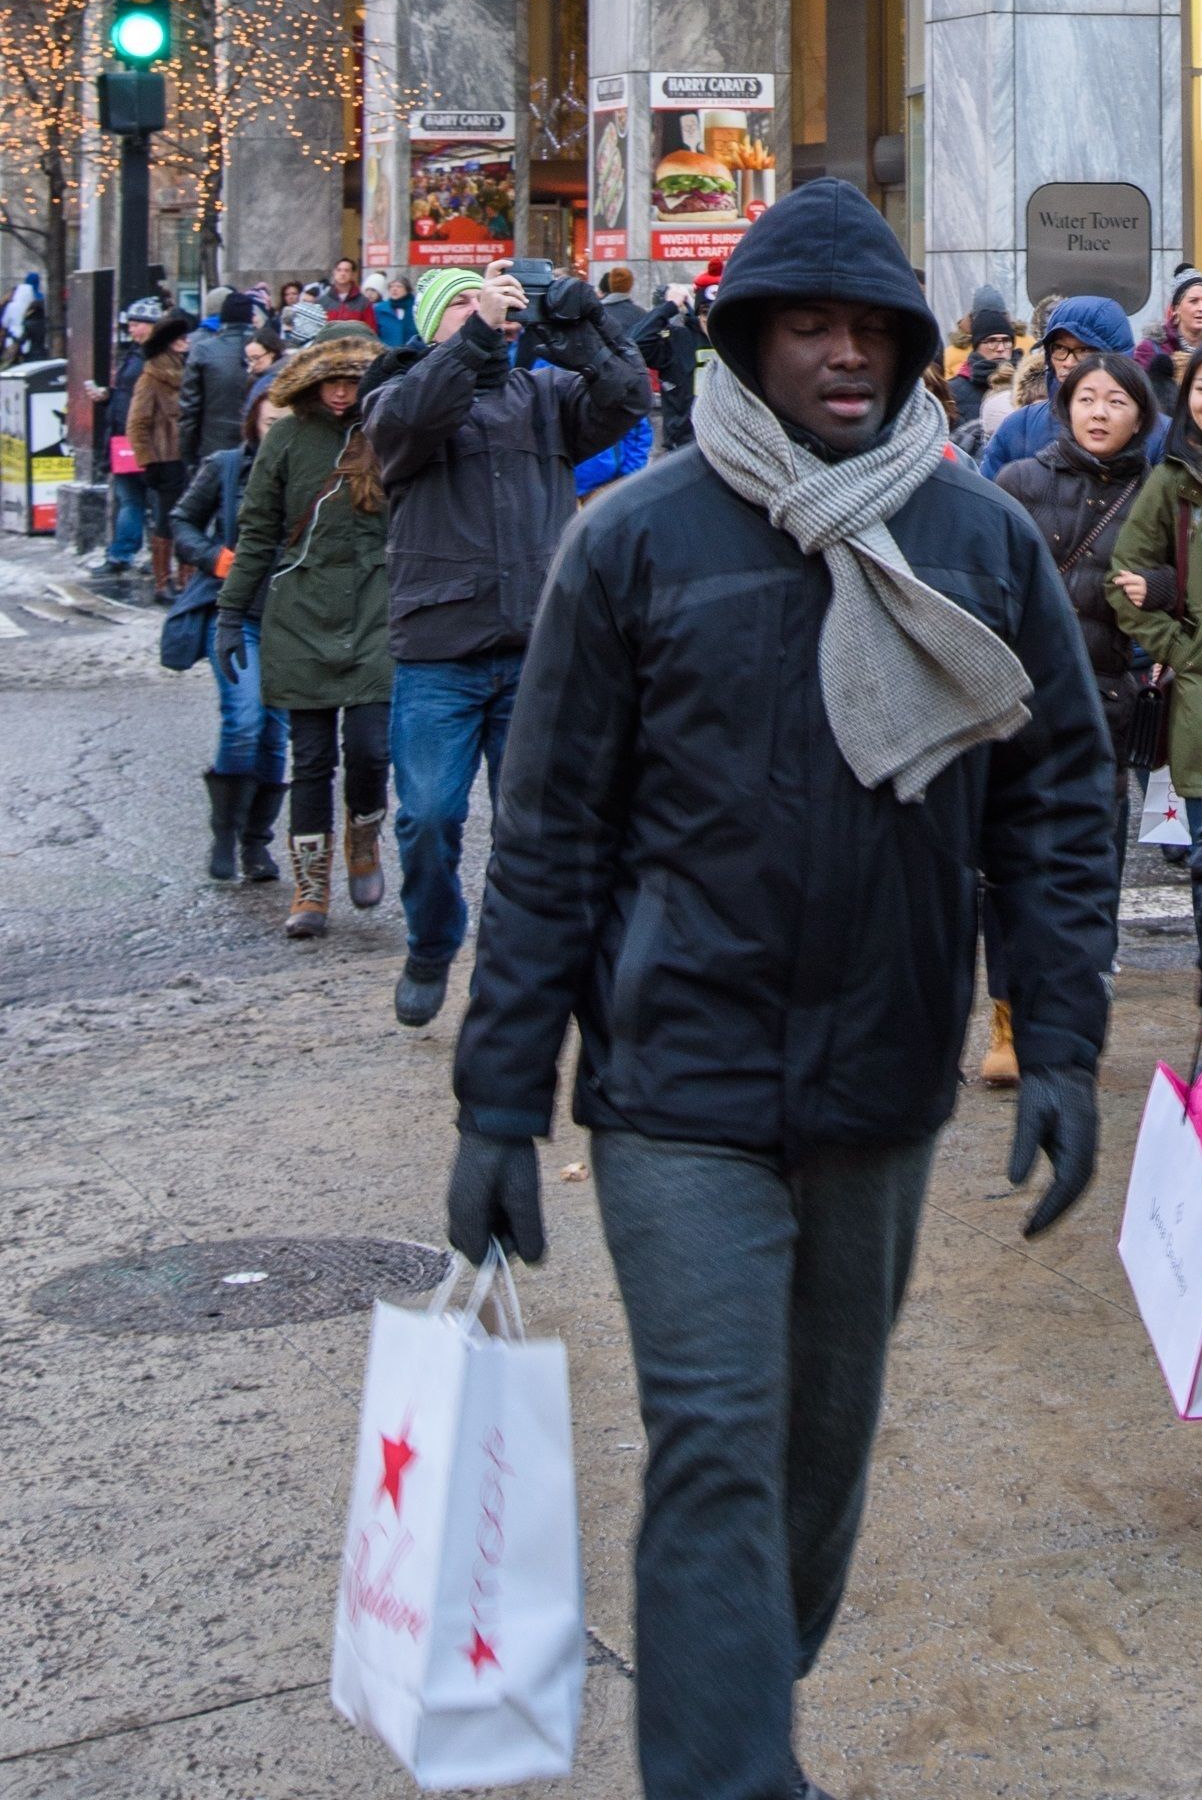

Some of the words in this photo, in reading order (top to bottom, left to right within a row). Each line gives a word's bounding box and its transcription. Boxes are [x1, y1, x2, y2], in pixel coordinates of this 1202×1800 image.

[668, 77, 706, 91] HARRY
[708, 77, 757, 91] CARAY'S
[1039, 212, 1087, 229] Water
[1089, 212, 1139, 229] Tower
[1067, 234, 1111, 251] Place
[664, 246, 696, 257] LOCAL
[697, 246, 728, 257] CRAFT
